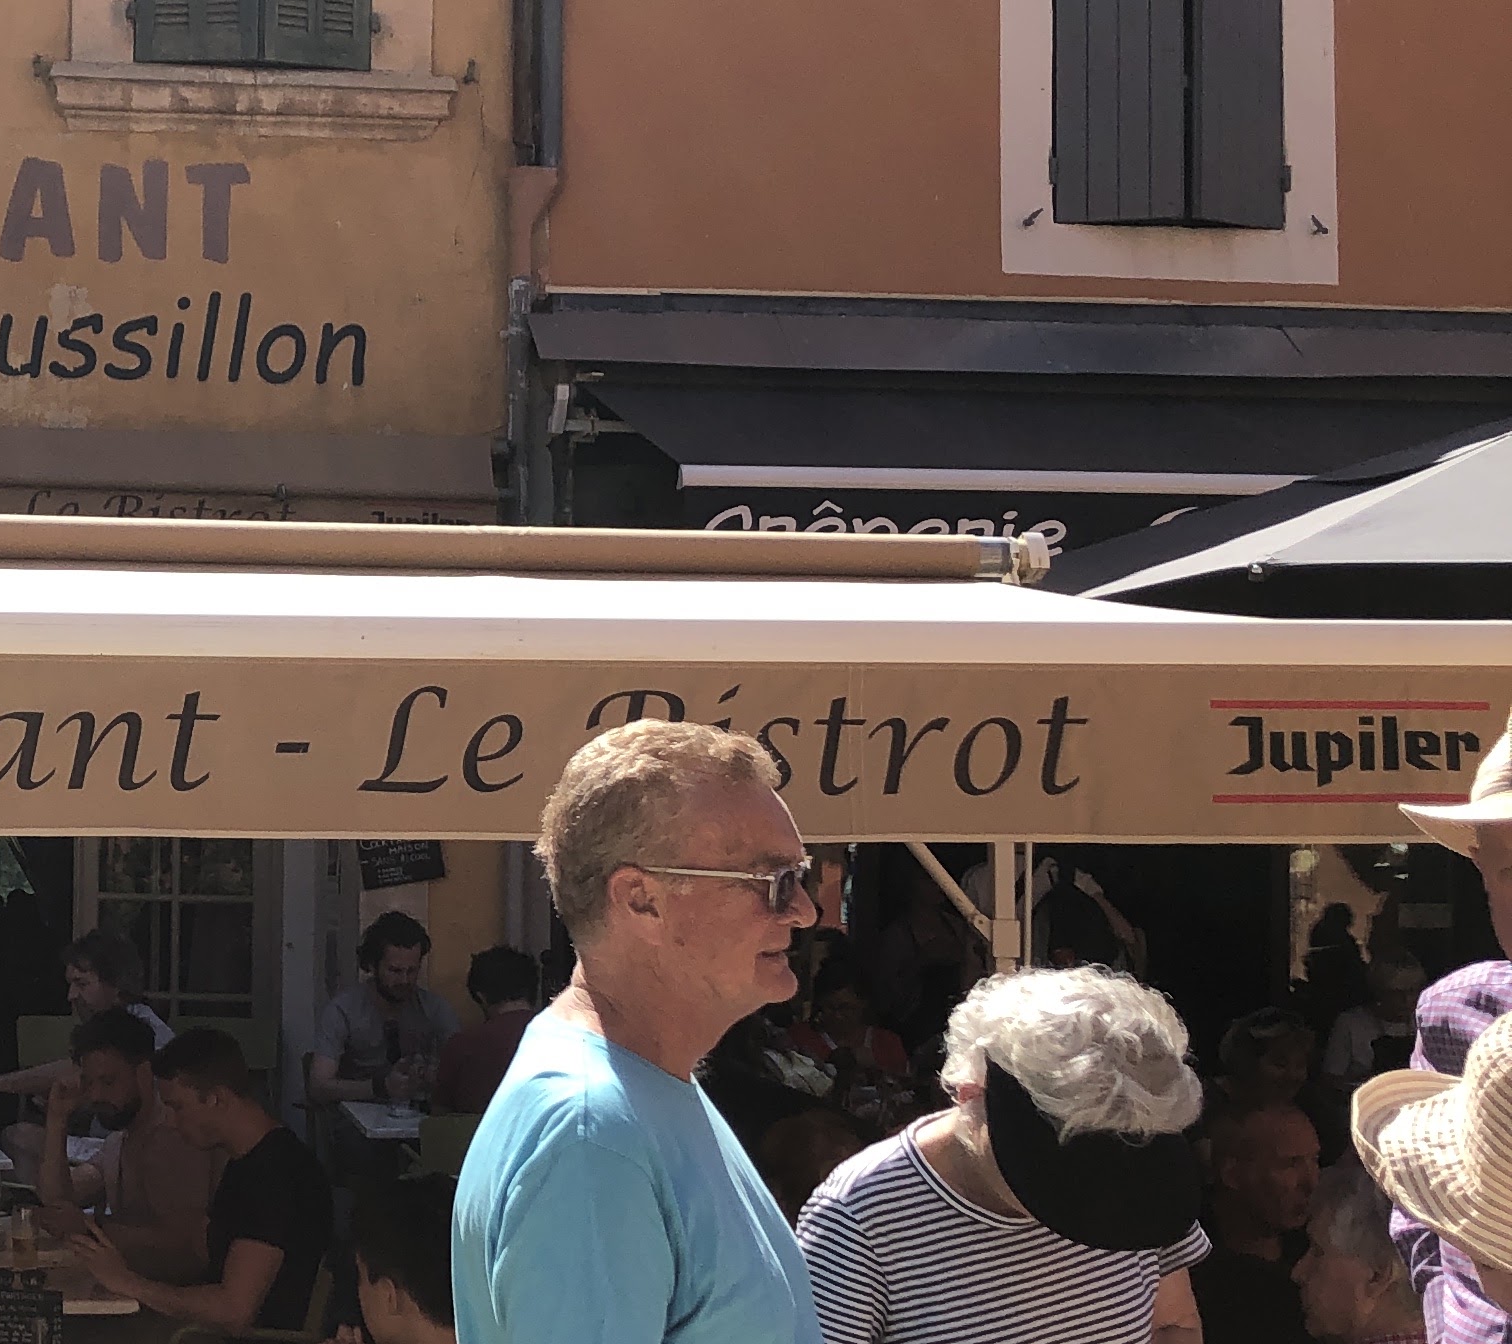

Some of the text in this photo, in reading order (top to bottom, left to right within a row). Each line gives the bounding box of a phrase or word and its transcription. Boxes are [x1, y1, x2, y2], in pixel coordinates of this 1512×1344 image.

[276, 738, 310, 754] -
[359, 685, 525, 793] Le
[586, 683, 1088, 796] strot
[1229, 715, 1481, 787] Jupiler
